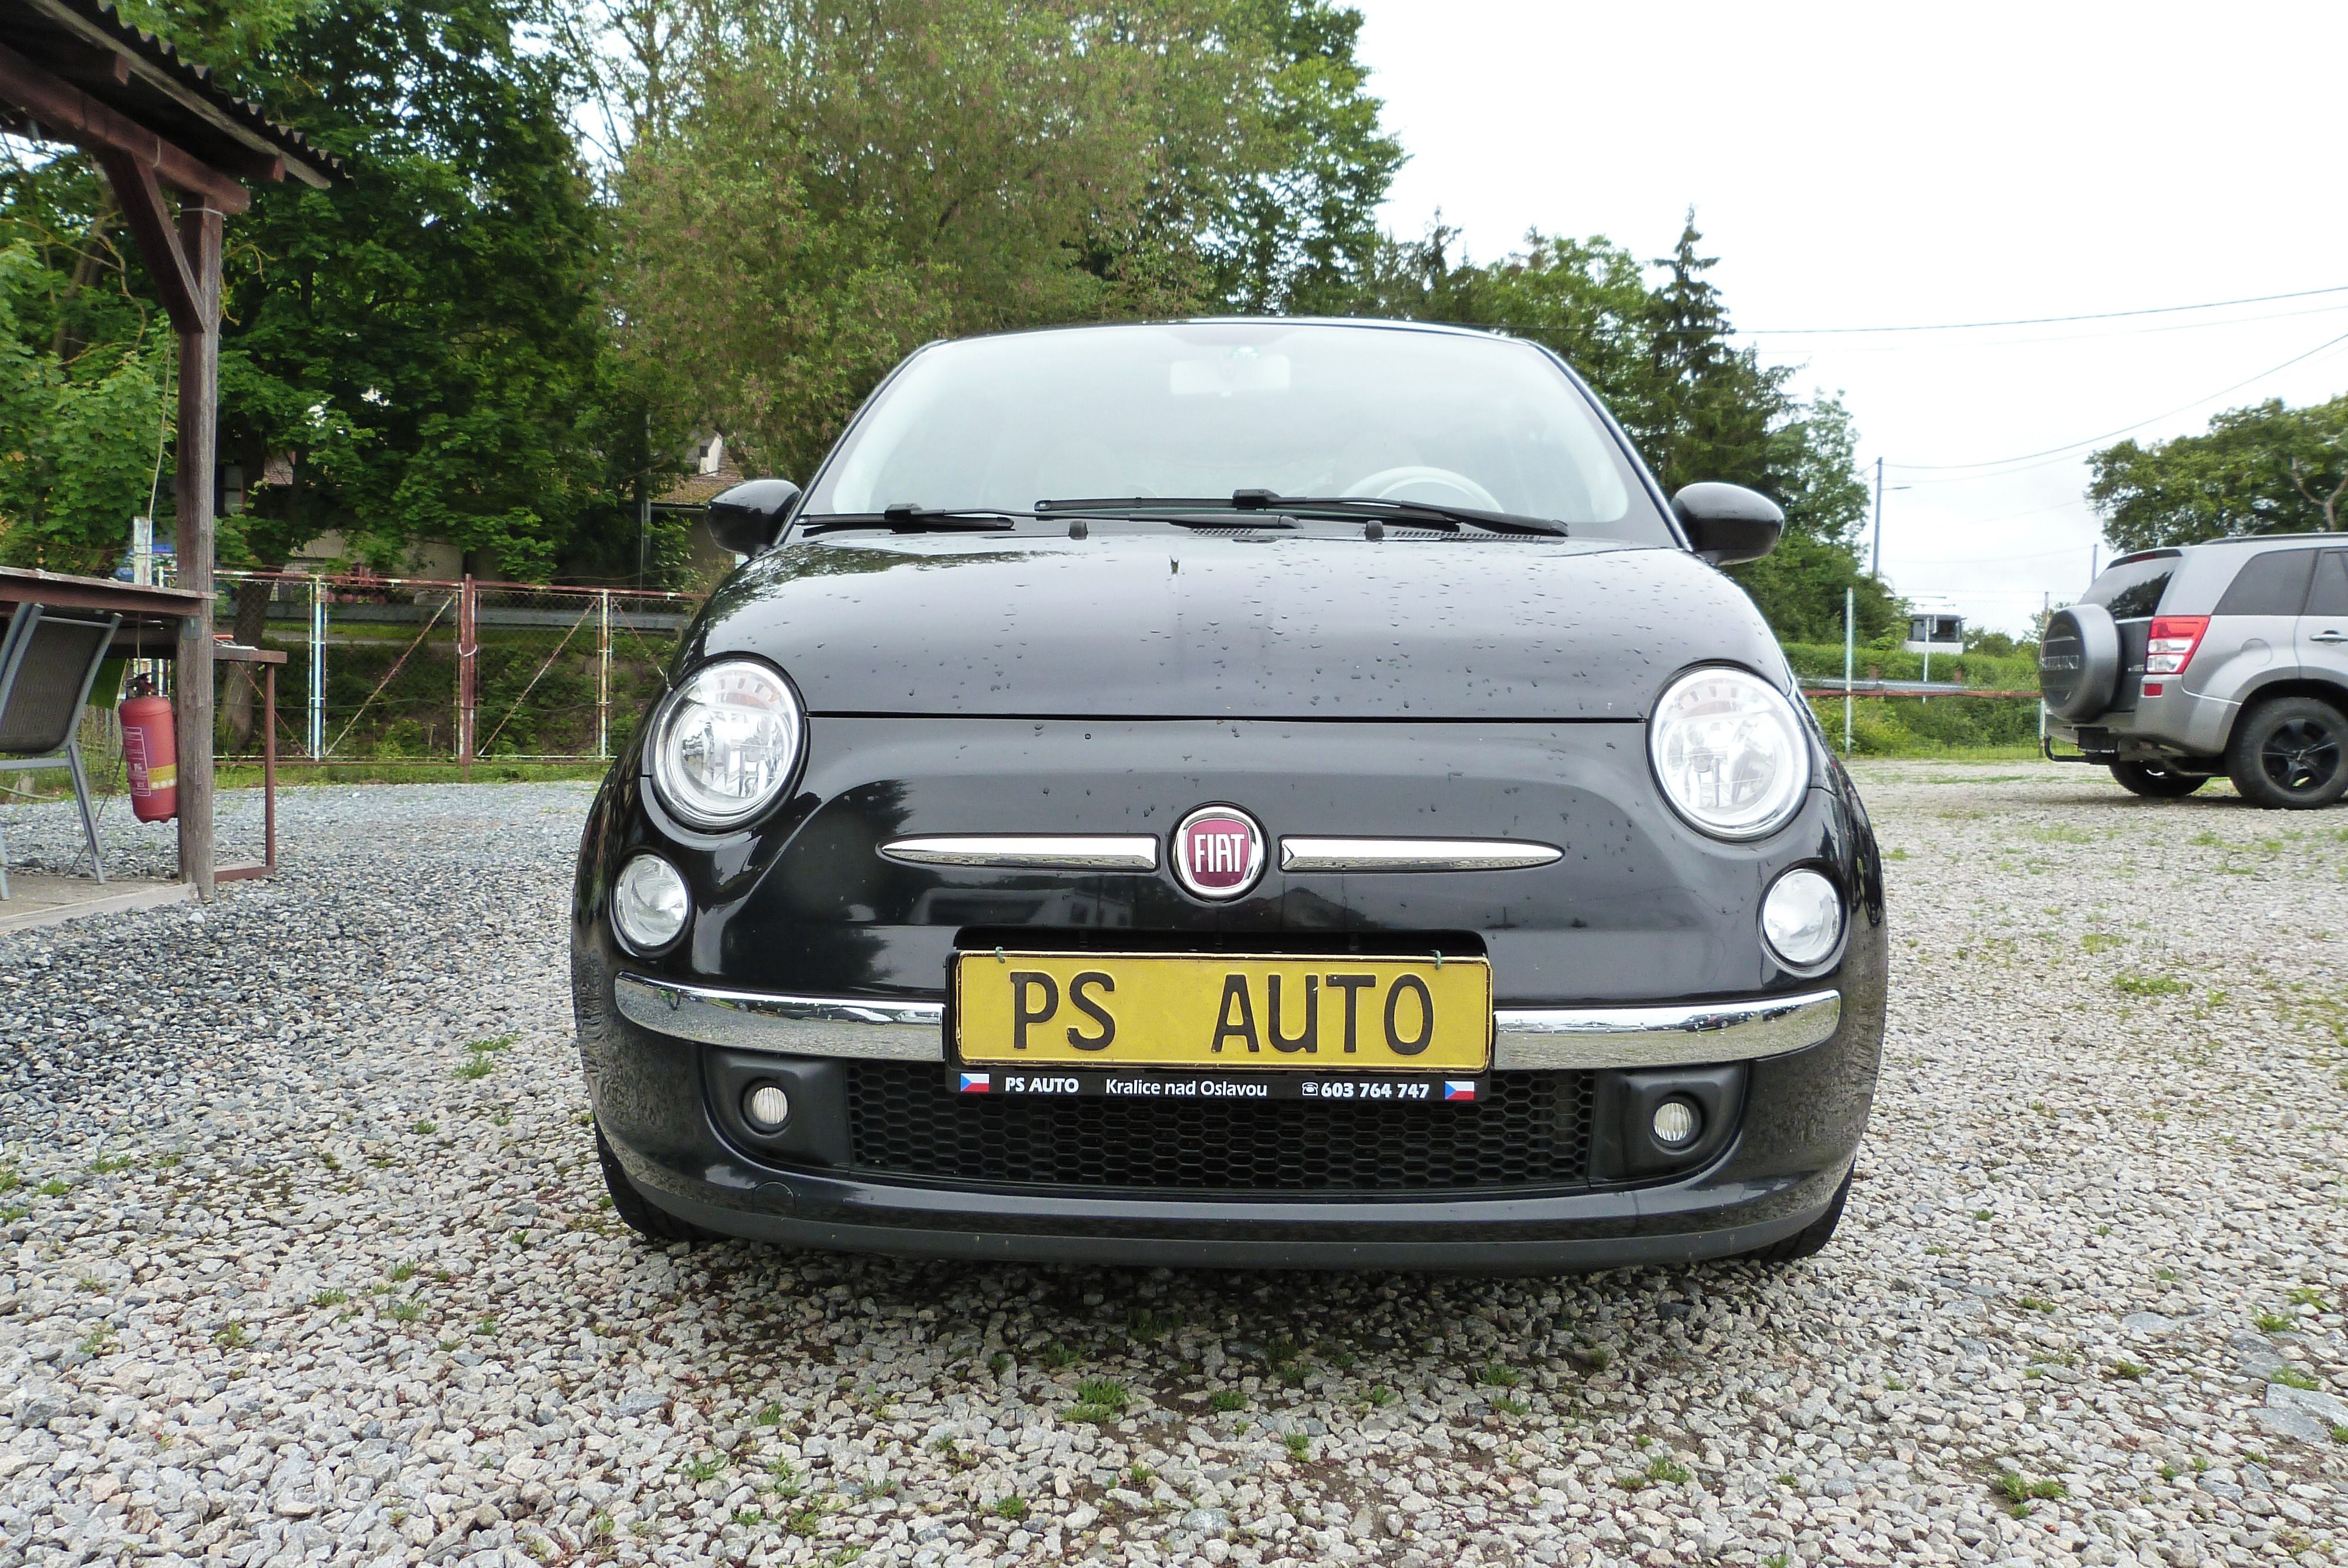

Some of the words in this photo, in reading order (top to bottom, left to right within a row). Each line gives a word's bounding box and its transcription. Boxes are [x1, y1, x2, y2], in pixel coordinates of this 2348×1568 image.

[1194, 833, 1245, 873] FIAT
[1010, 971, 1116, 1052] PS
[1211, 974, 1434, 1056] AUTO
[1005, 1077, 1025, 1092] PS
[1028, 1077, 1079, 1093] AUTO
[1106, 1079, 1161, 1095] Kralice
[1165, 1080, 1196, 1096] nad
[1200, 1080, 1267, 1097] Oslavou
[1321, 1082, 1354, 1098] 603
[1359, 1083, 1392, 1099] 764
[1397, 1083, 1429, 1099] 747
